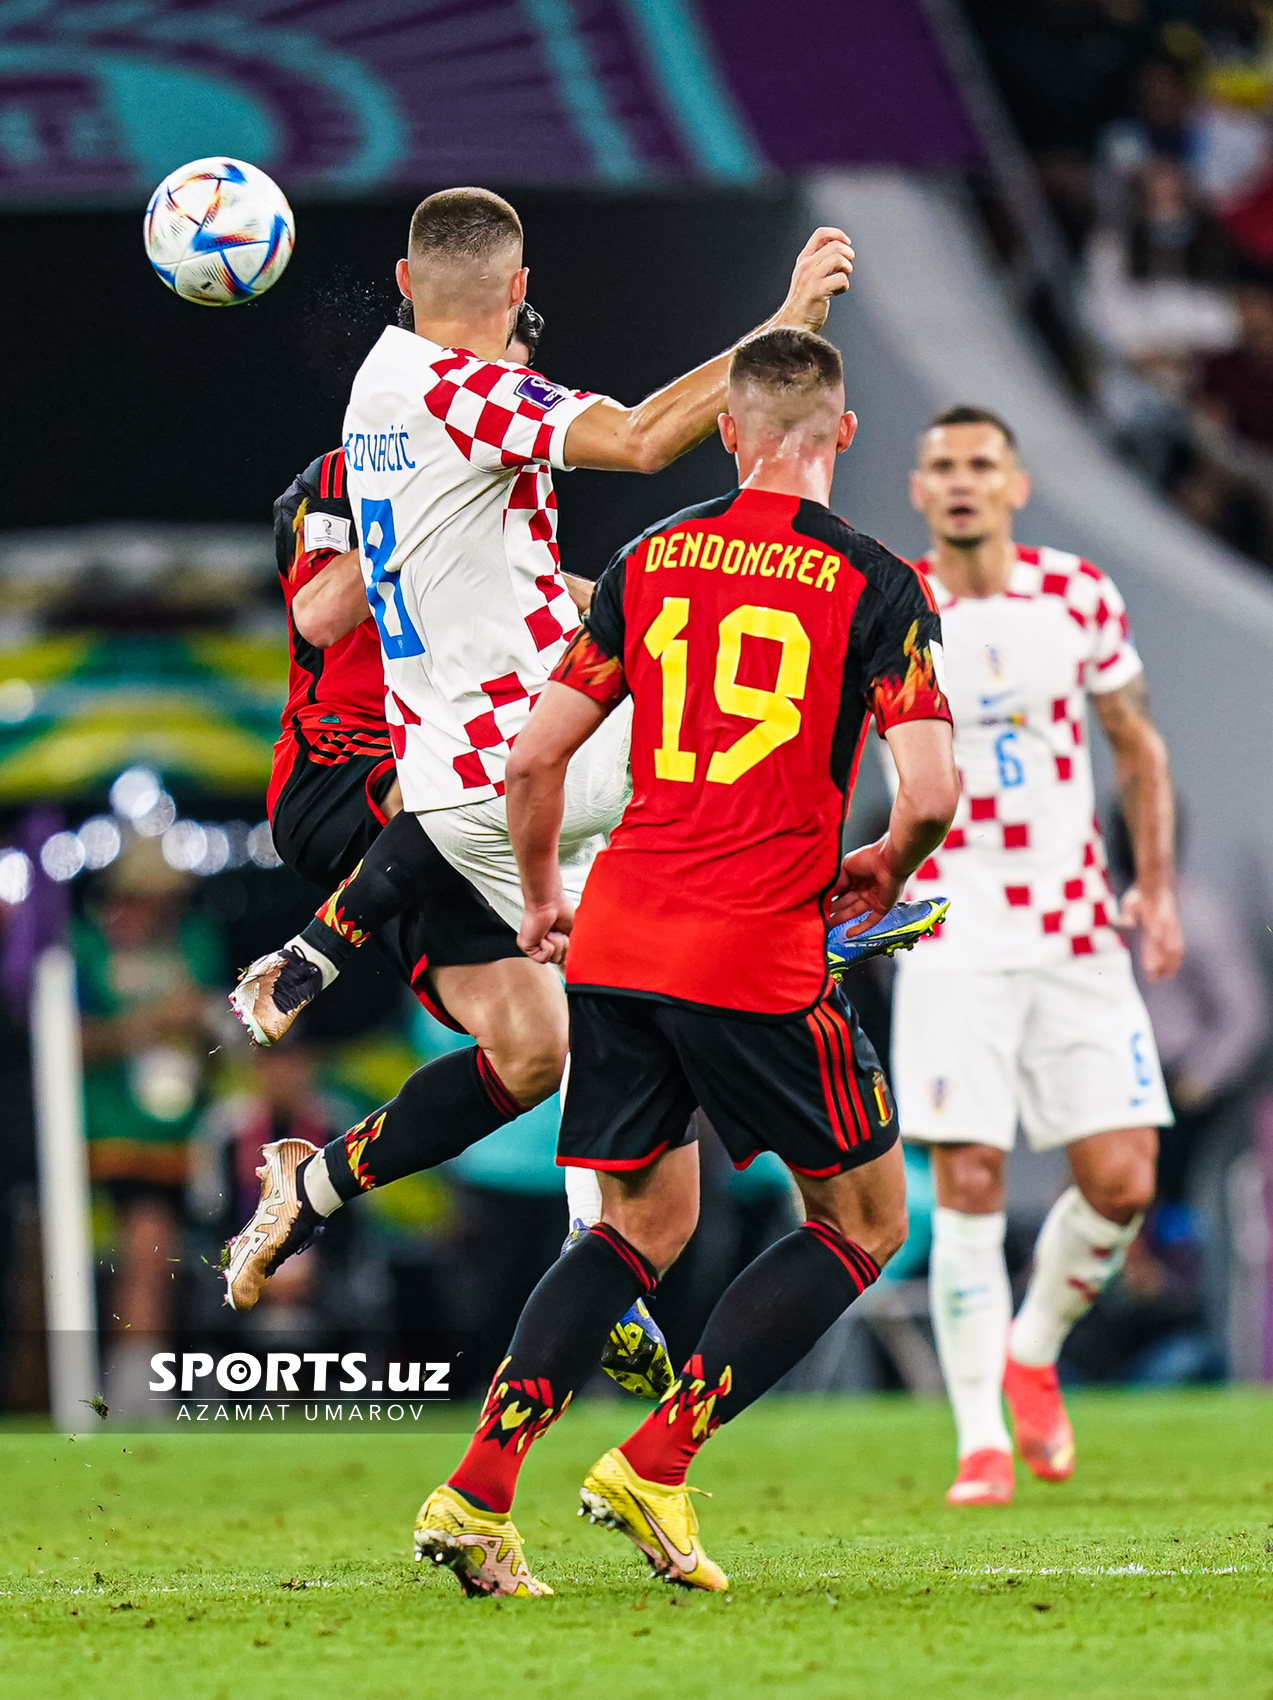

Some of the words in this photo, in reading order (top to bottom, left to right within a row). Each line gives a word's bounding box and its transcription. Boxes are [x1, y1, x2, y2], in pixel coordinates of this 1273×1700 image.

[361, 498, 426, 660] 8
[645, 532, 841, 592] DENDONCKER
[643, 597, 811, 785] 19
[994, 731, 1025, 789] 6
